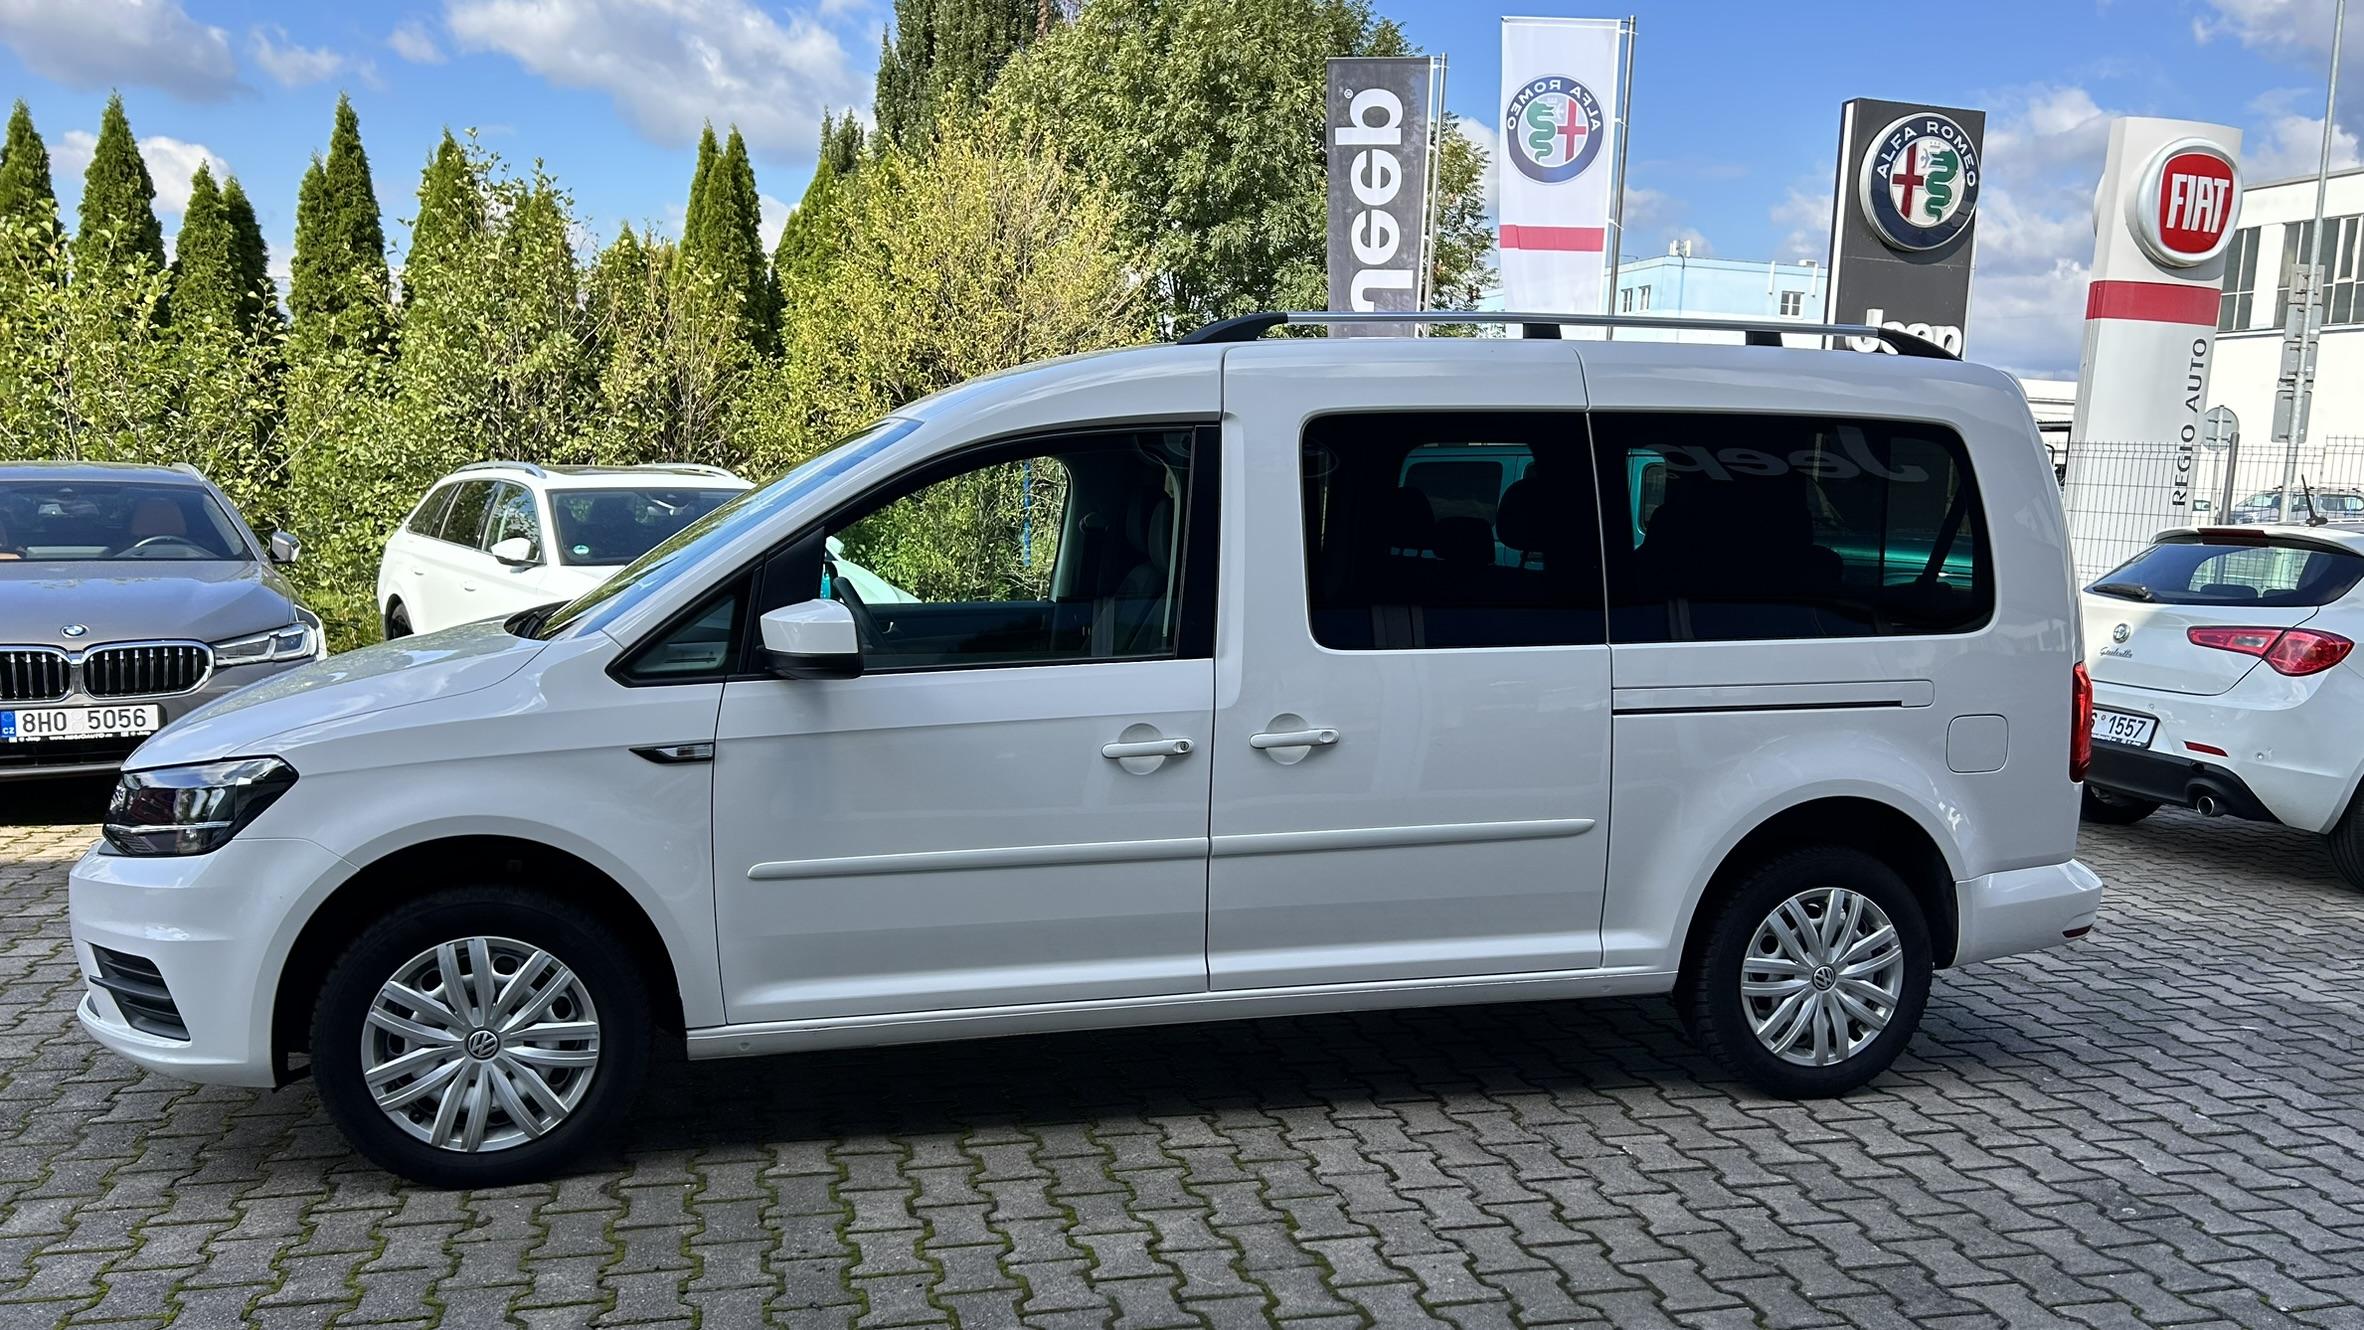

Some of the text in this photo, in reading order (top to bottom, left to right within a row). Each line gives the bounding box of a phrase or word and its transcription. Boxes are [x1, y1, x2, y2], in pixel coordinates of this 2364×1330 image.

[1876, 120, 1977, 188] ALFA ROMEO
[2165, 172, 2231, 234] FIAT
[2172, 337, 2208, 507] REGIO AUTO
[2, 726, 15, 735] CZ
[87, 708, 147, 730] 5056
[2108, 715, 2147, 739] 1557
